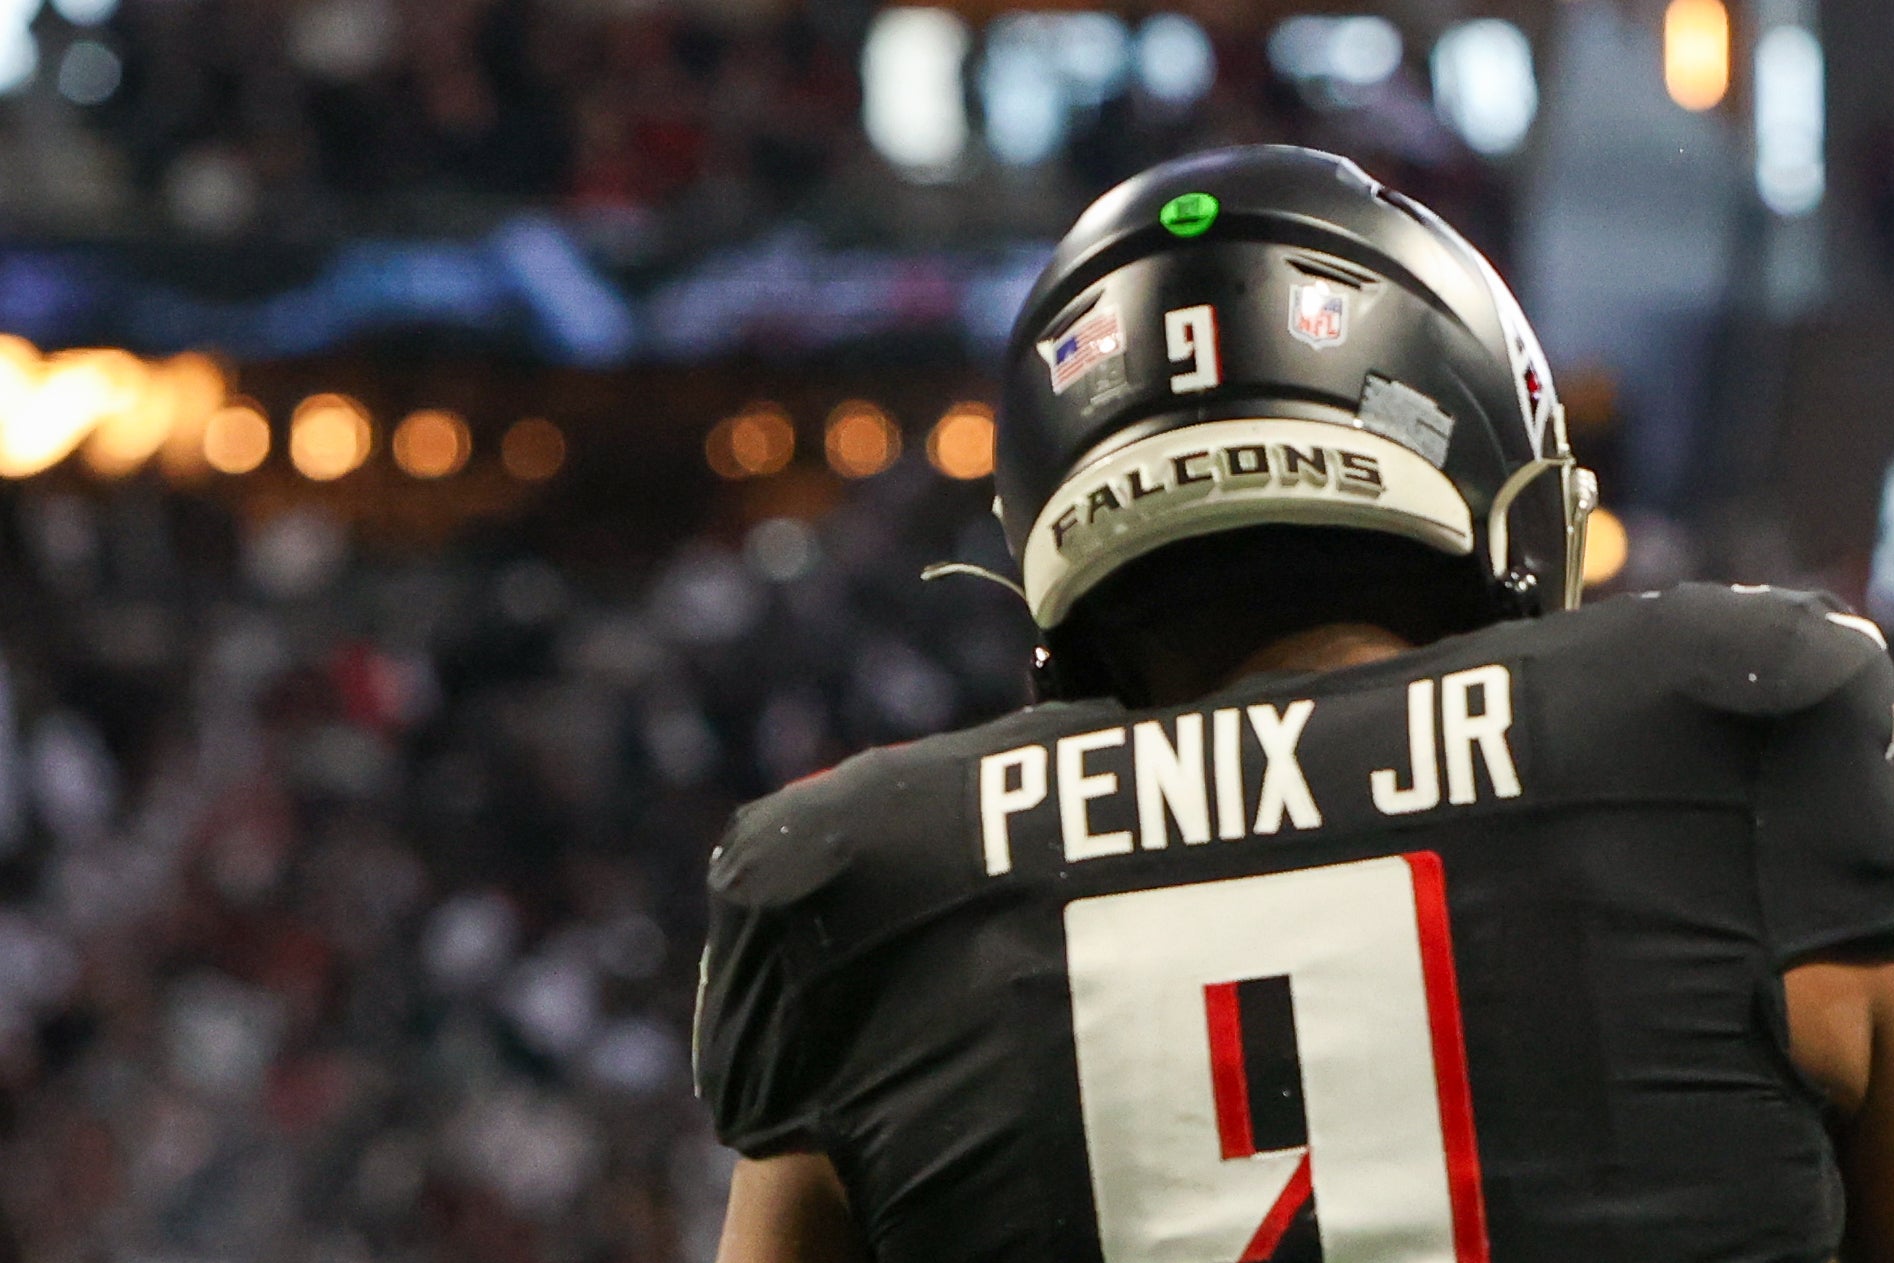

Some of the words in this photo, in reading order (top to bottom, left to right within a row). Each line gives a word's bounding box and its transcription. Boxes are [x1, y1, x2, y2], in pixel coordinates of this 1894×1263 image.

[1164, 303, 1224, 395] 9
[1051, 444, 1384, 549] FALCONS
[979, 699, 1323, 878] PENIX
[1370, 664, 1523, 816] JR
